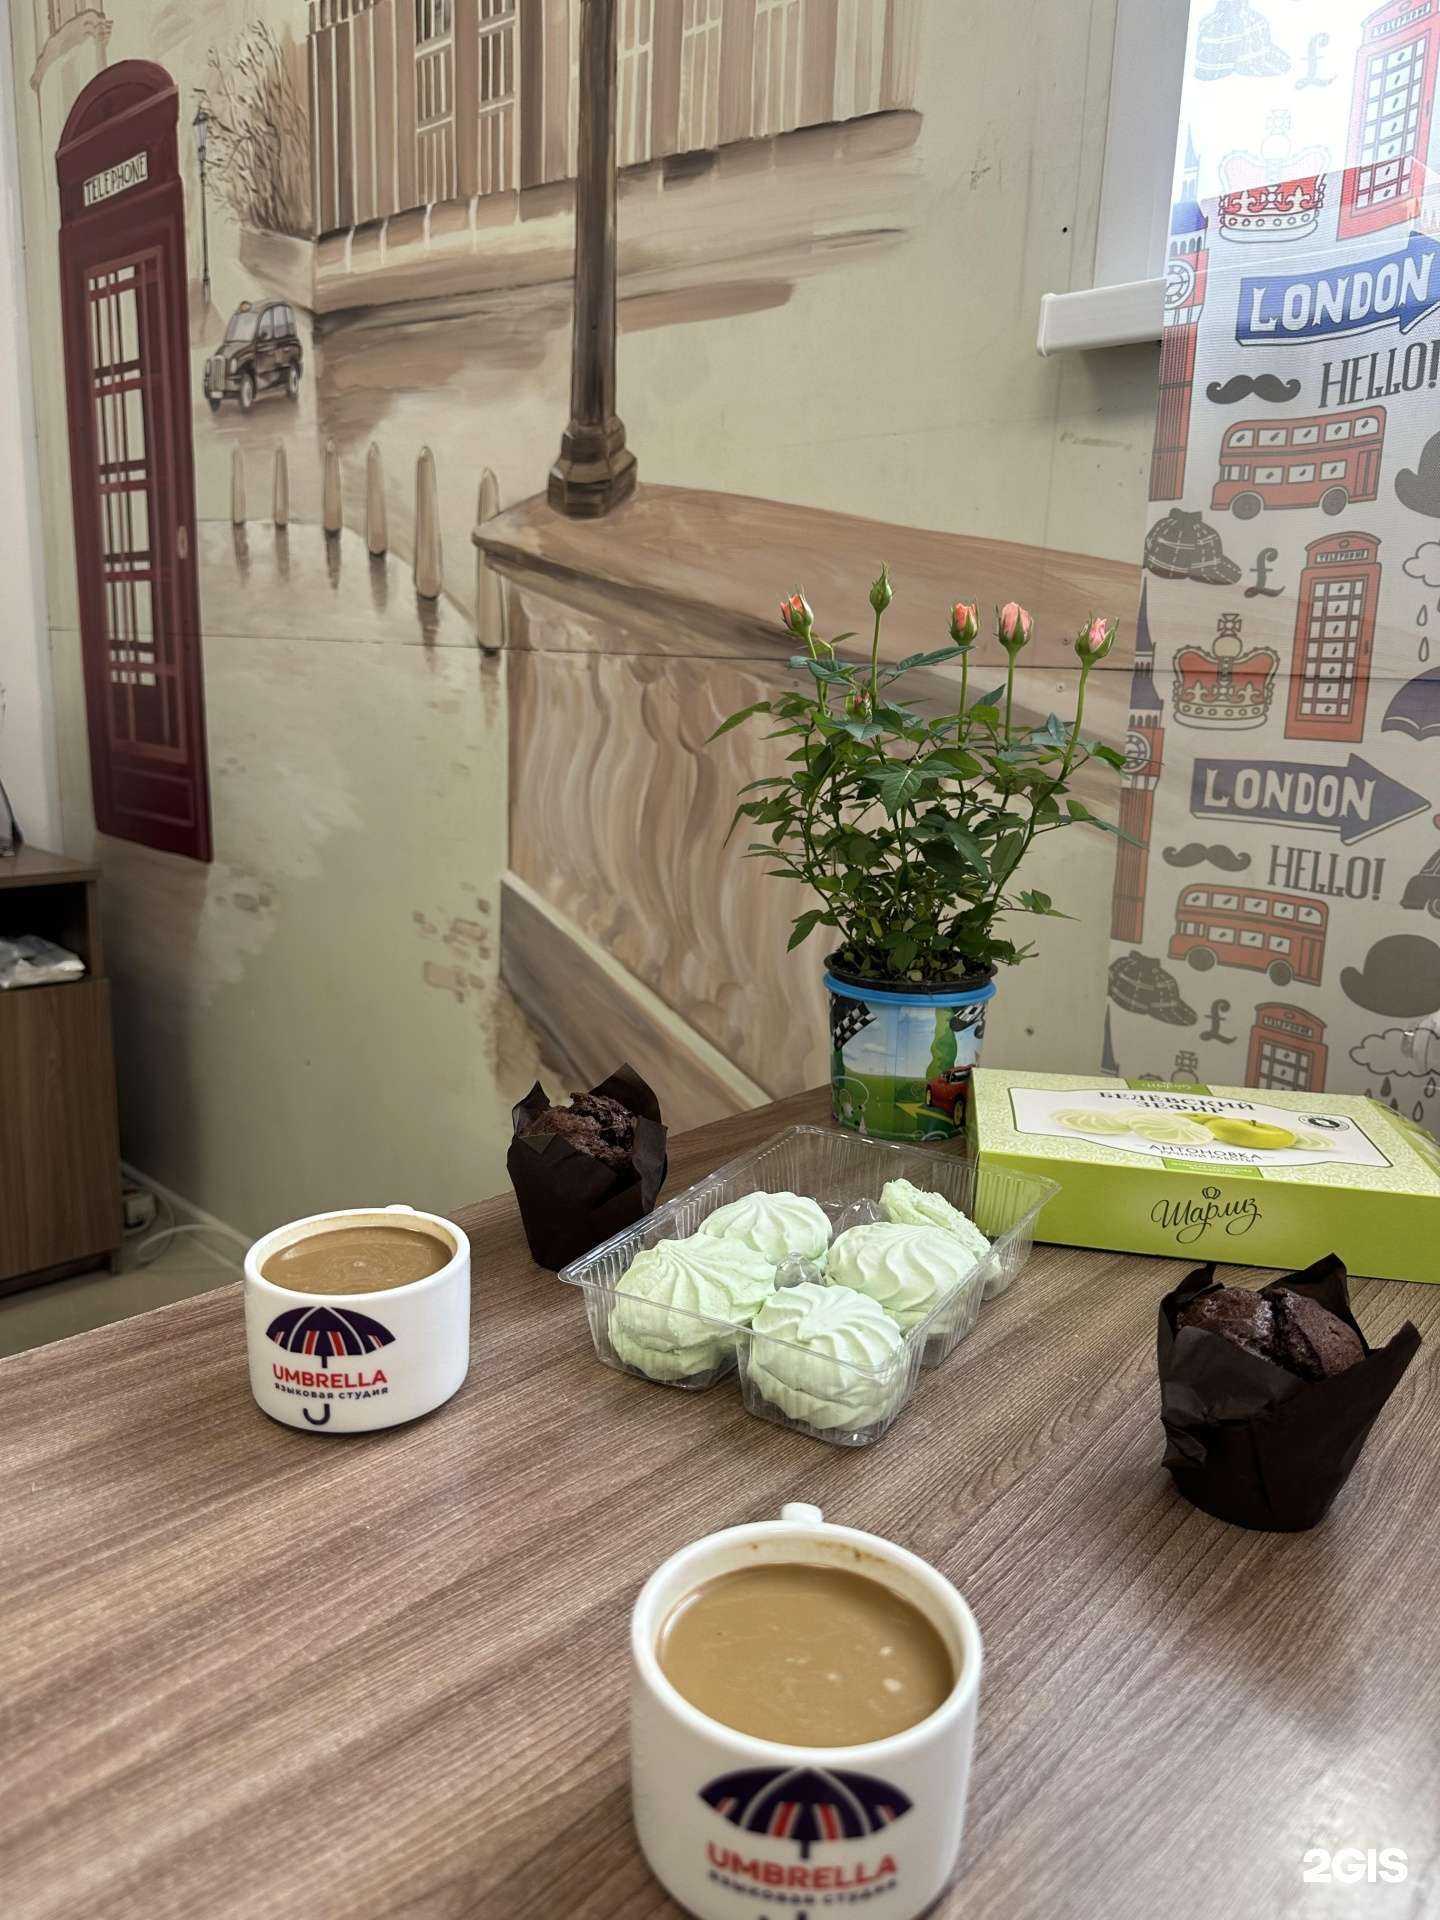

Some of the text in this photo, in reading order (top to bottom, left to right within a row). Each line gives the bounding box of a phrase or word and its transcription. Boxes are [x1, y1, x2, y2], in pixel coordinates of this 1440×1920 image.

[84, 153, 147, 204] TELEPHONE
[1250, 252, 1435, 332] LONDON
[1318, 339, 1440, 408] HELLO!
[1203, 768, 1376, 821] LONDON
[1267, 845, 1386, 901] HELLO!
[1138, 1101, 1223, 1113] ЗЕФИР
[1149, 1144, 1263, 1160] АНТОНОВКА
[272, 1363, 388, 1389] UMBRELLA
[706, 1841, 897, 1889] UMBRELLA
